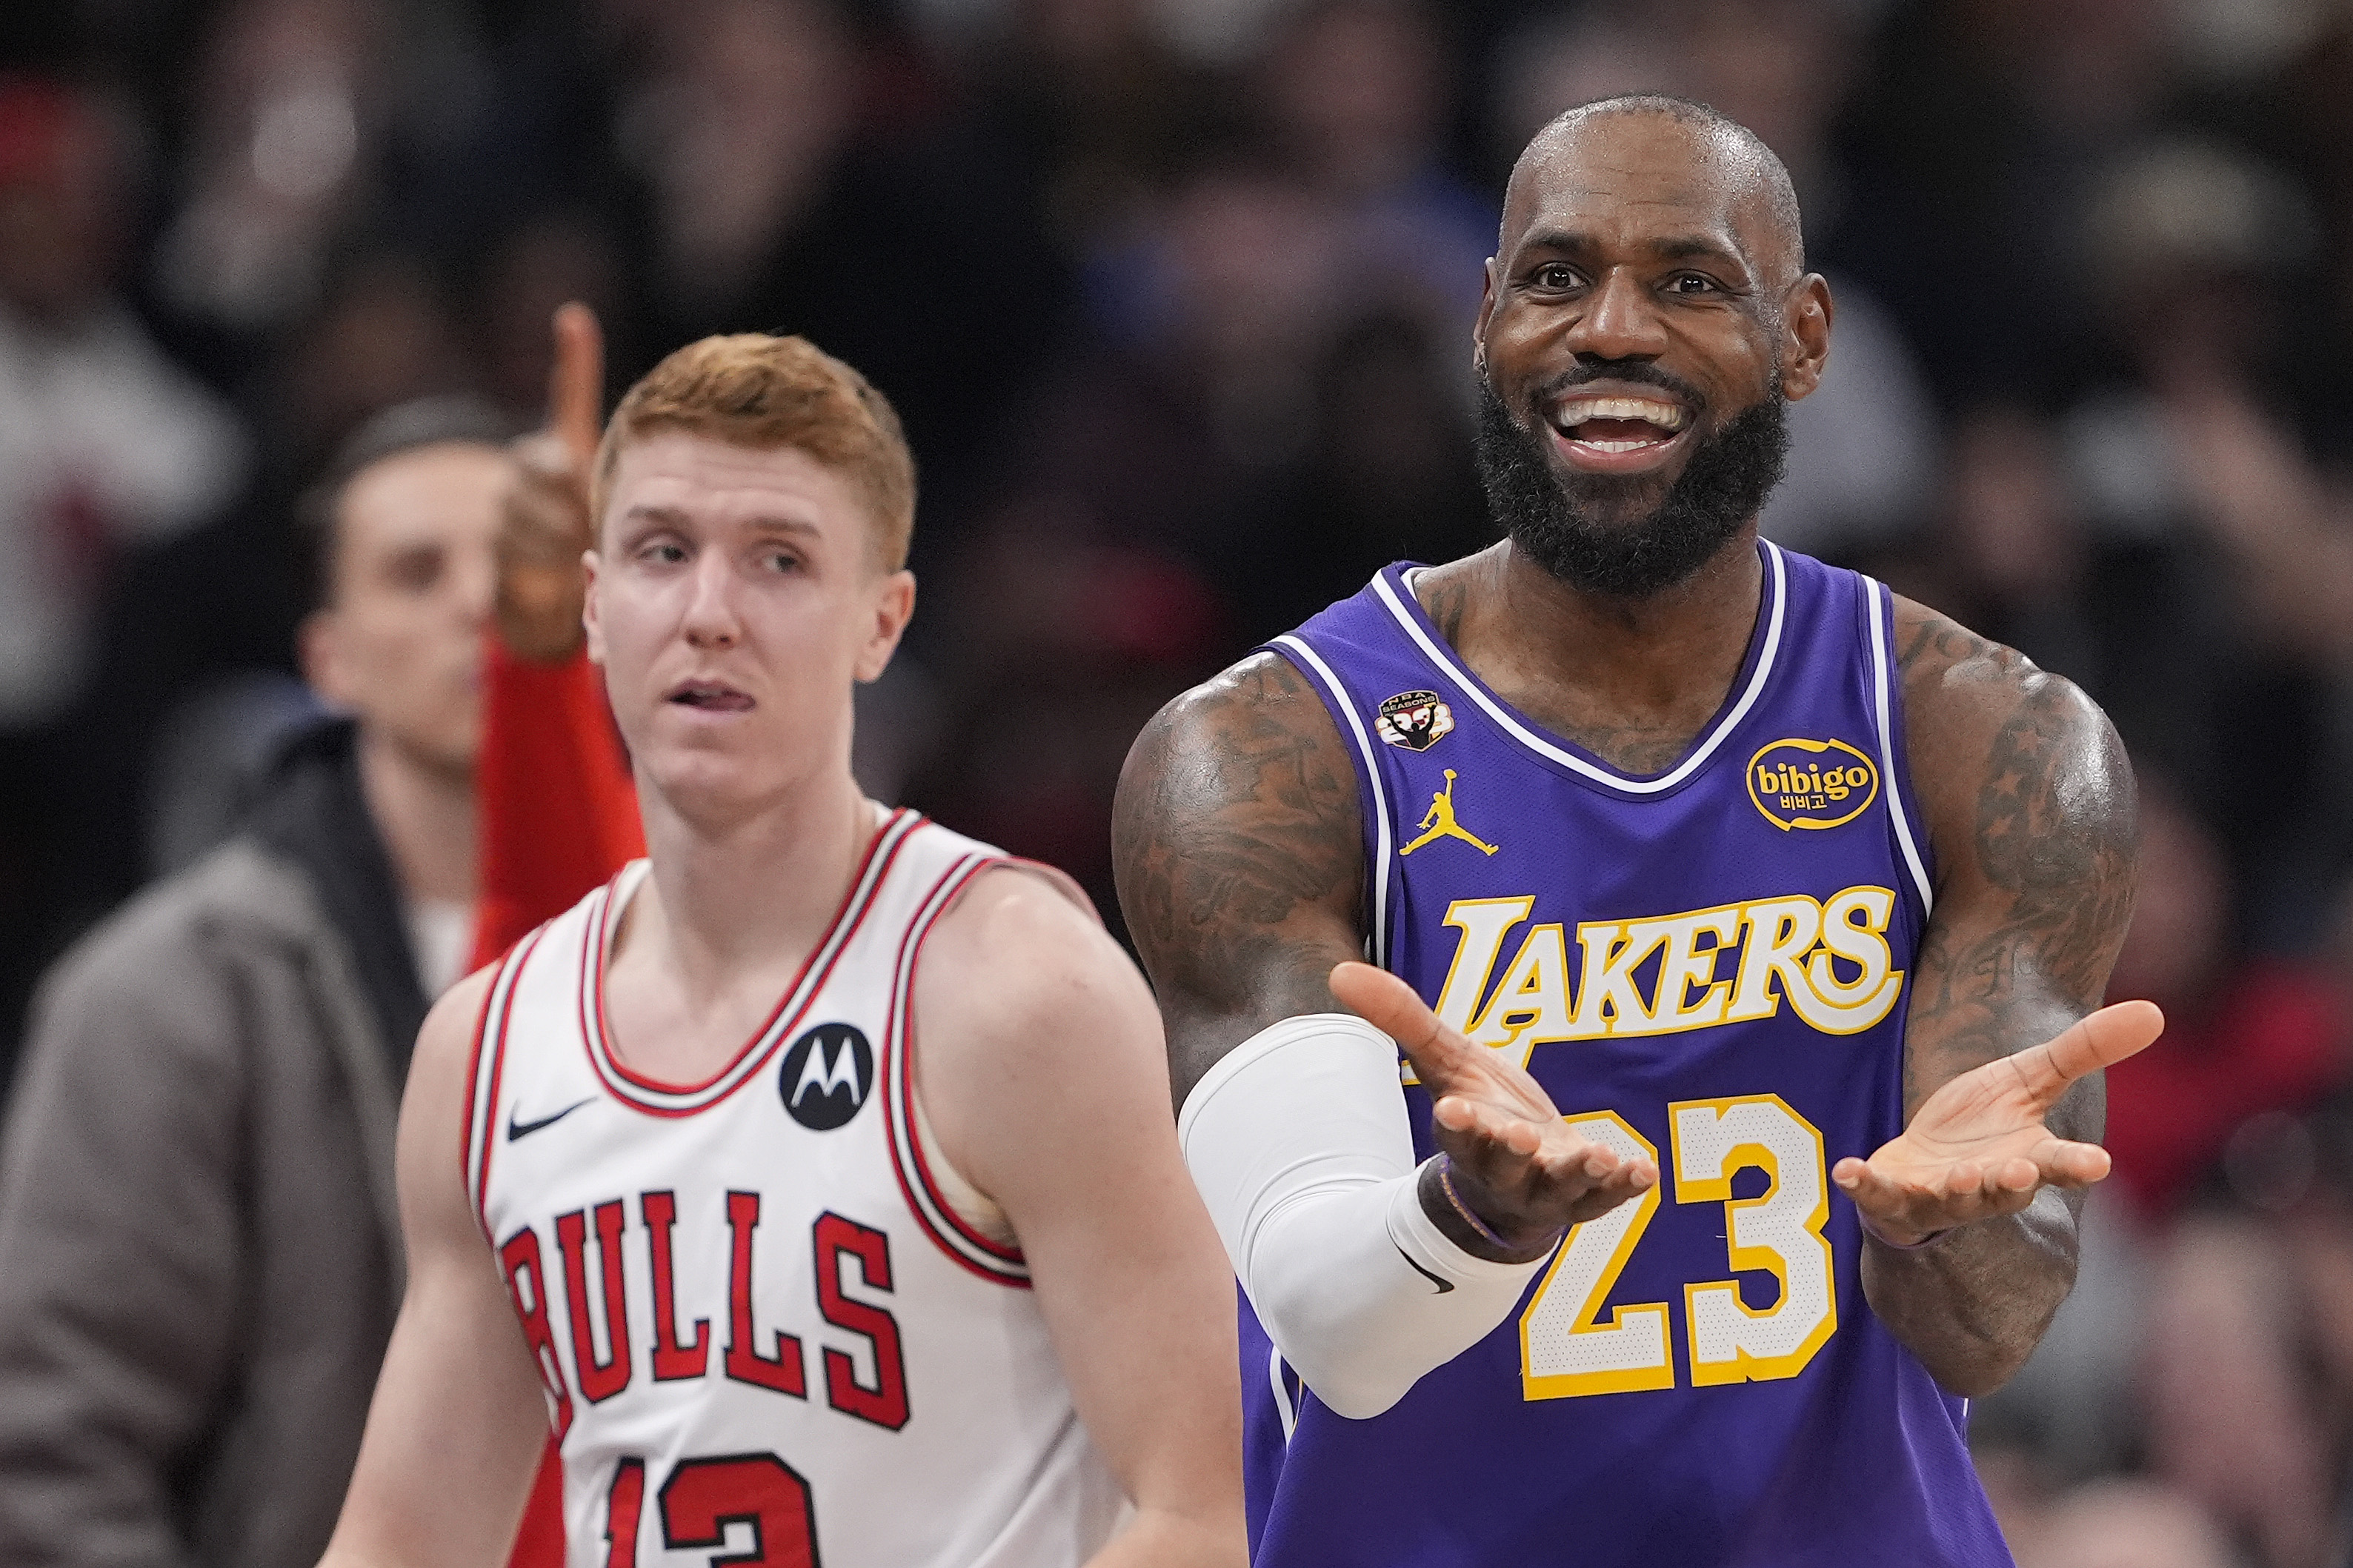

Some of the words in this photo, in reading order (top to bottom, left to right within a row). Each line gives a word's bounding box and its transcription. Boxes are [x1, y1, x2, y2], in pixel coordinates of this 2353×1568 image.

[1382, 695, 1436, 713] SEASONS
[1388, 693, 1426, 706] NBA
[1757, 762, 1869, 801] bibigo
[1780, 794, 1828, 811] 비비고
[1402, 884, 1905, 1085] LAKERS
[1519, 1093, 1838, 1401] 23
[500, 1188, 911, 1449] BULLS
